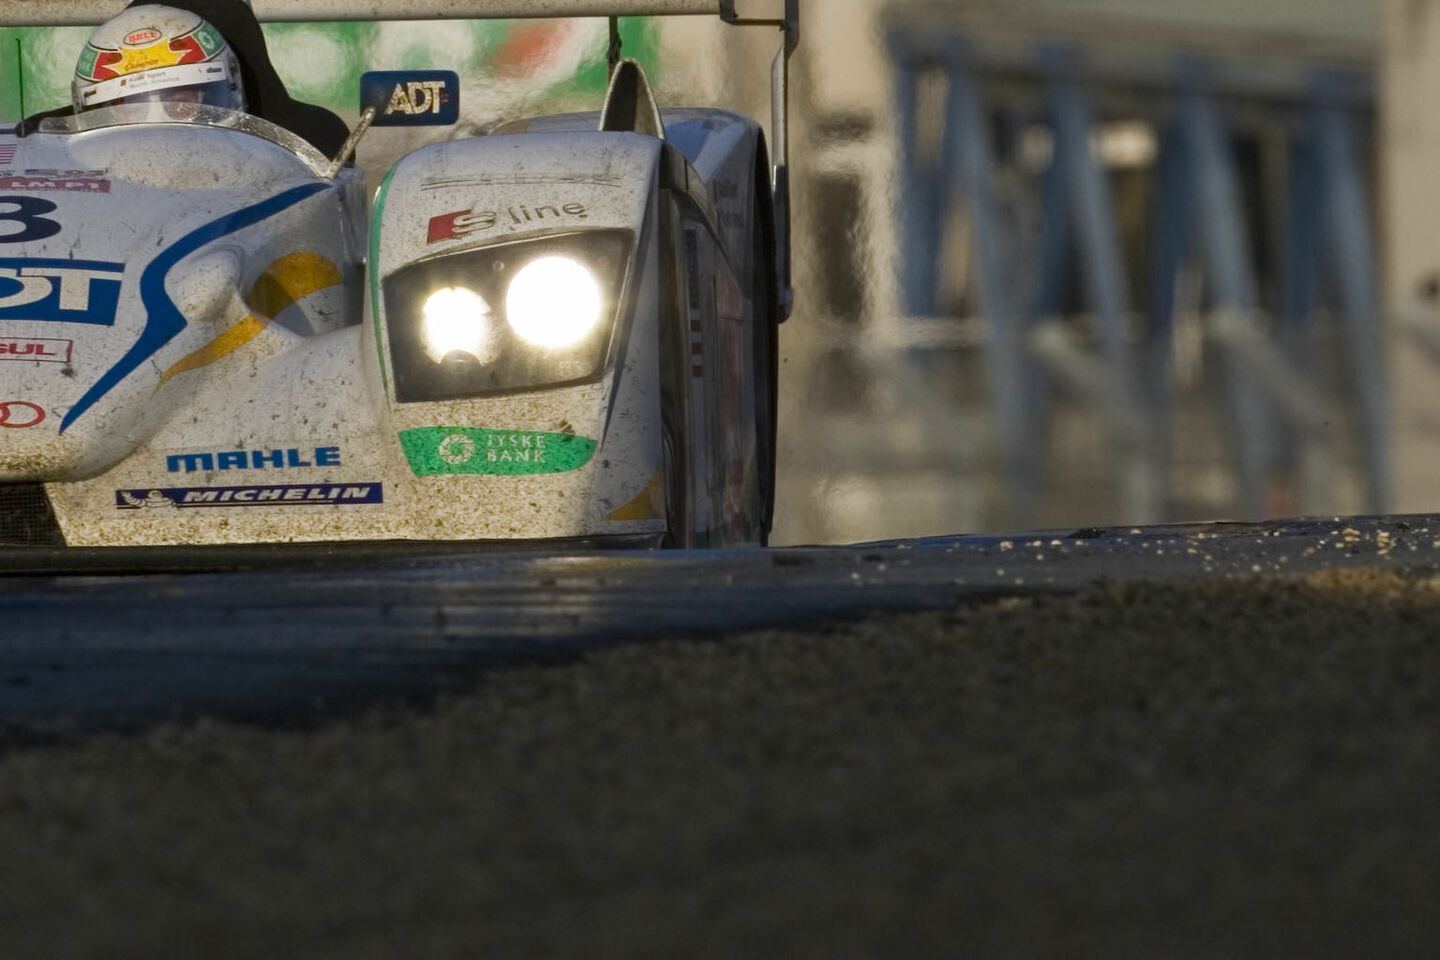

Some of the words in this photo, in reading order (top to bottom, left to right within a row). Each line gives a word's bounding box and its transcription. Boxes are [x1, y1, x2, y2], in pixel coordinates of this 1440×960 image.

[383, 80, 446, 115] ADT
[507, 203, 585, 225] line
[487, 435, 546, 448] JYSKE
[166, 446, 341, 472] MAHLE
[487, 449, 546, 463] BANK
[182, 487, 370, 503] MICHELIN
